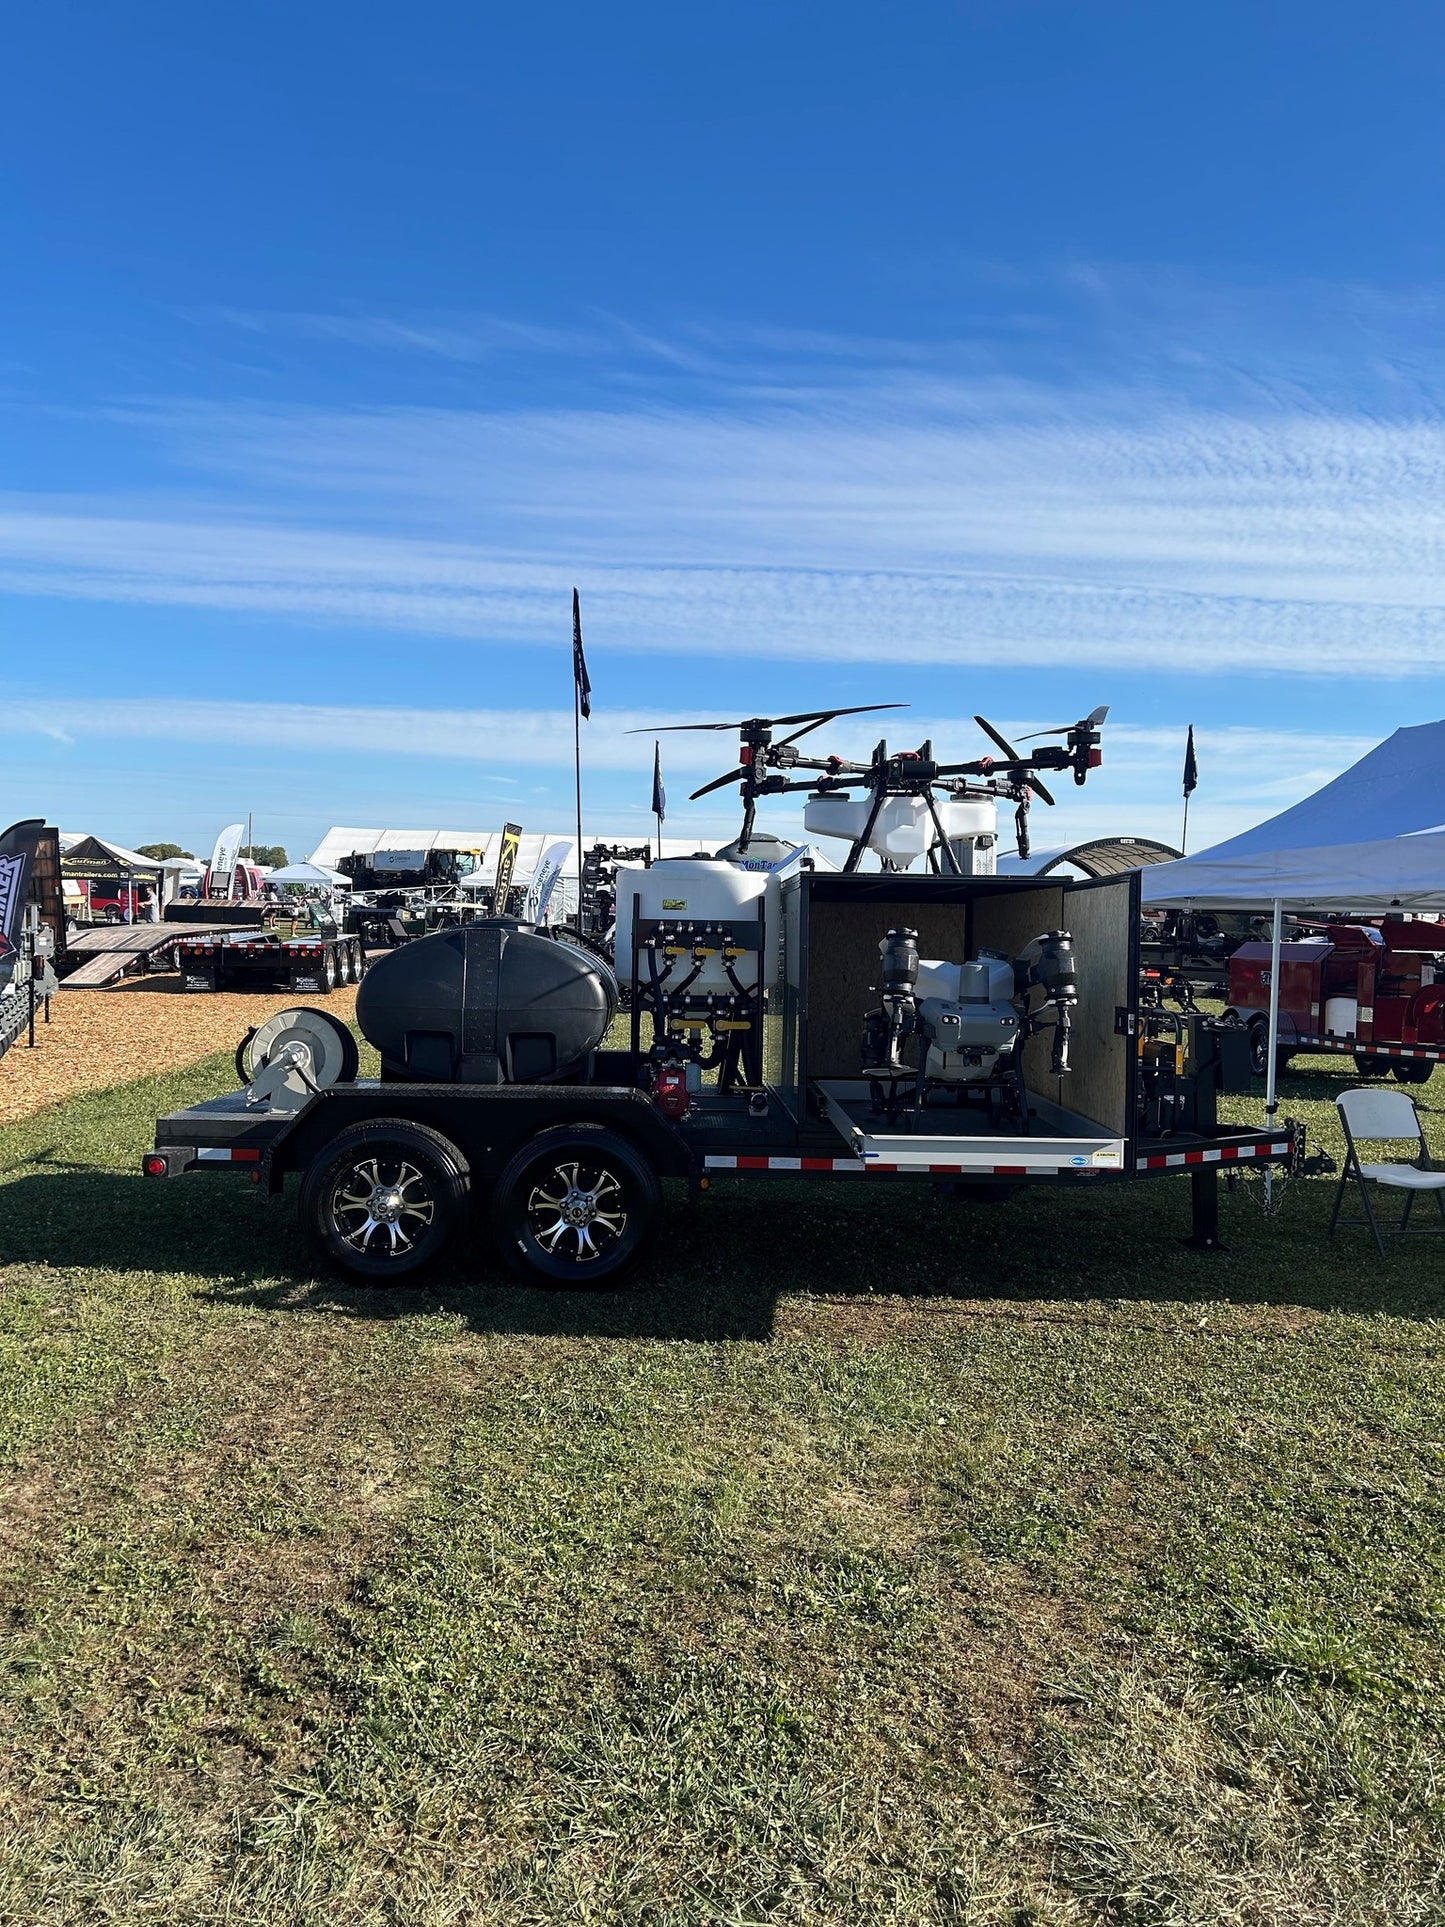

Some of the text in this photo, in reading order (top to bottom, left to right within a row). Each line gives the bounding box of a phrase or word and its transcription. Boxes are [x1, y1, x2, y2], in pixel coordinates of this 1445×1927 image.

[217, 847, 227, 870] eneye
[61, 870, 118, 879] fmantrailers.com
[532, 859, 551, 895] Greeneye
